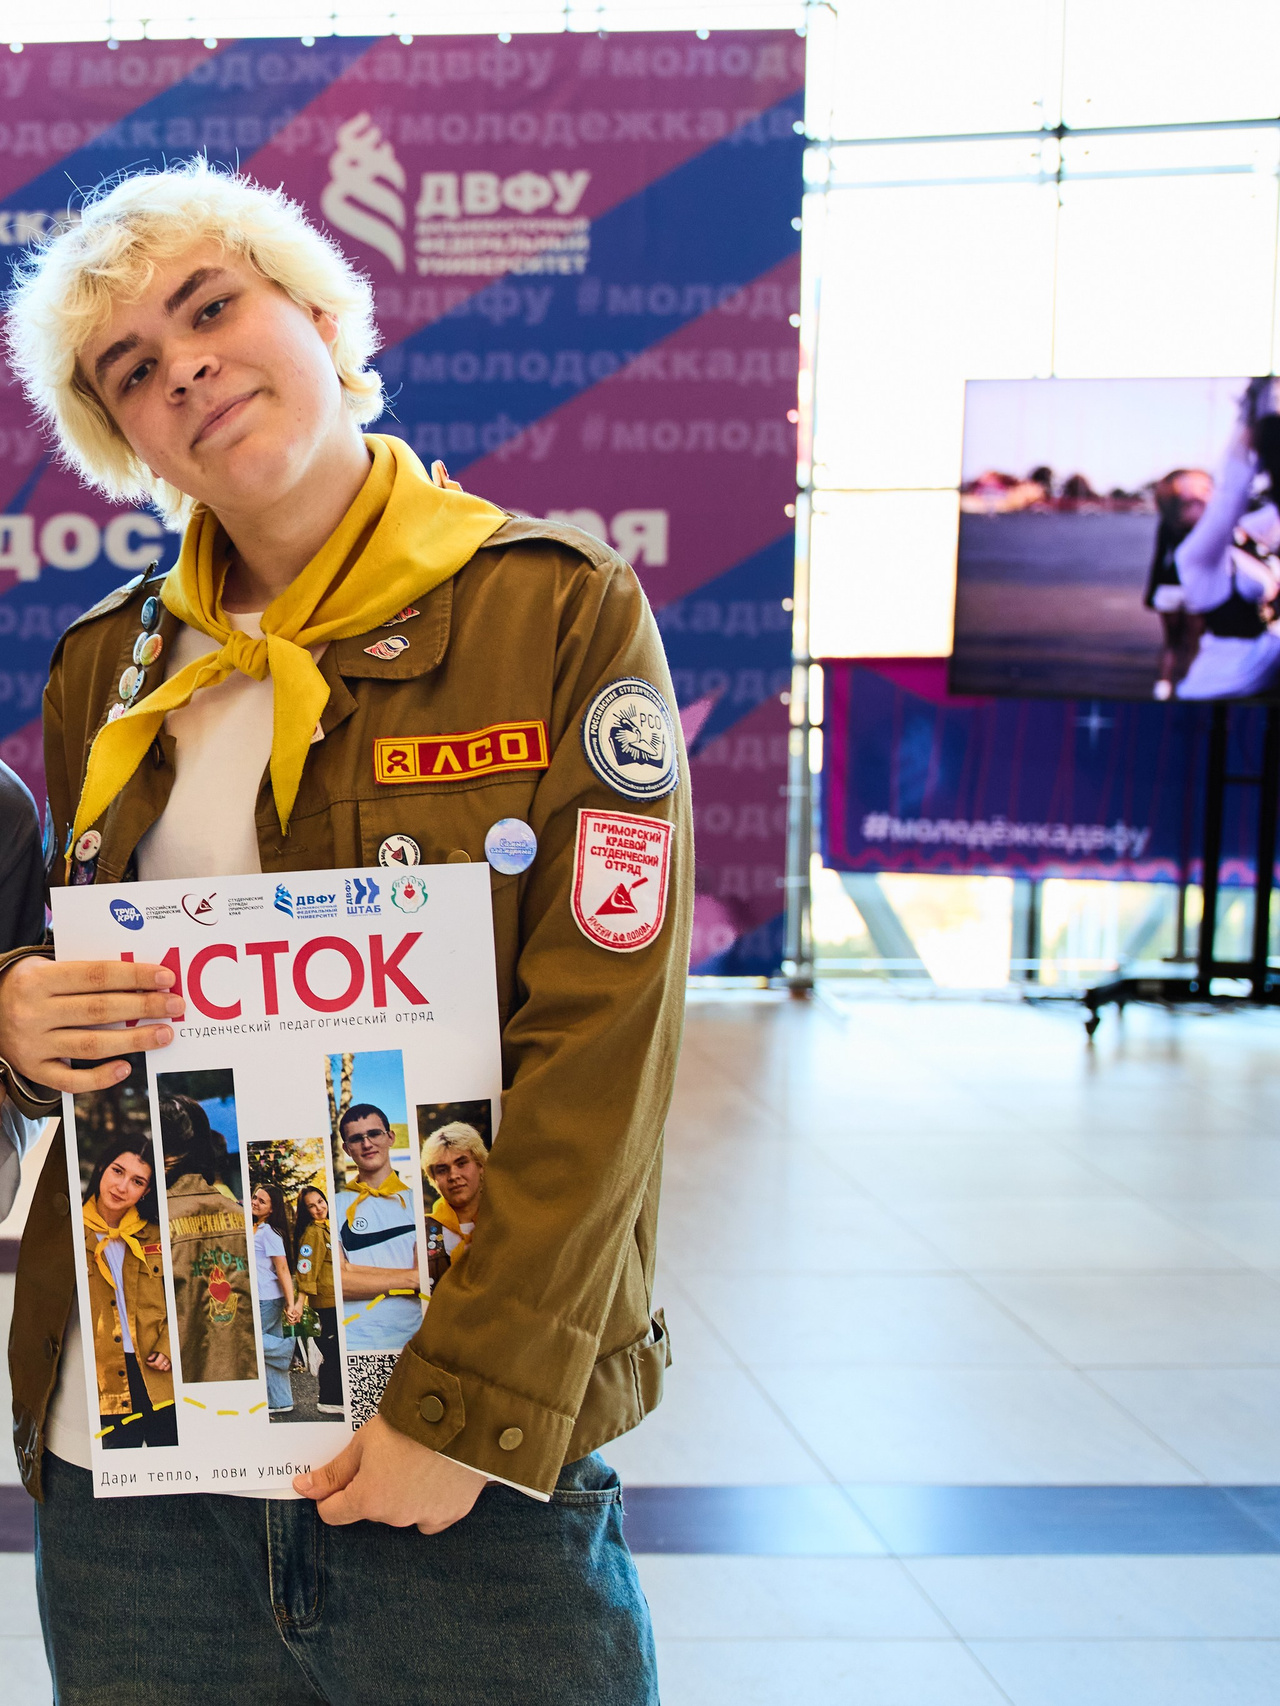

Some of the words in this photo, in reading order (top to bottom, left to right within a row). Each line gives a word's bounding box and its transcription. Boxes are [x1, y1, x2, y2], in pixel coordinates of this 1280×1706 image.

[416, 169, 591, 219] ДВФУ
[639, 712, 662, 730] РСО
[593, 822, 661, 843] ПРИМОРСКИЙ
[606, 836, 646, 852] КРАЕВОЙ
[590, 846, 659, 867] СТУДЕНЧЕСКИЙ
[605, 860, 641, 877] ОТРЯД
[296, 894, 337, 907] ДВФУ
[344, 878, 354, 905] ДВФУ
[114, 907, 135, 916] ТРУД
[117, 914, 141, 922] КРУТ
[347, 904, 381, 915] ШТАБ
[587, 915, 612, 939] ИМЕНИ
[179, 1020, 272, 1040] студенческий
[278, 1011, 388, 1034] педагогический
[395, 1009, 436, 1025] отряд
[355, 1220, 365, 1228] FC
[192, 1249, 246, 1277] ИСТОК
[101, 1470, 138, 1487] Дари
[148, 1468, 200, 1483] тепло,
[211, 1466, 248, 1480] лови
[257, 1461, 312, 1479] улыбки
